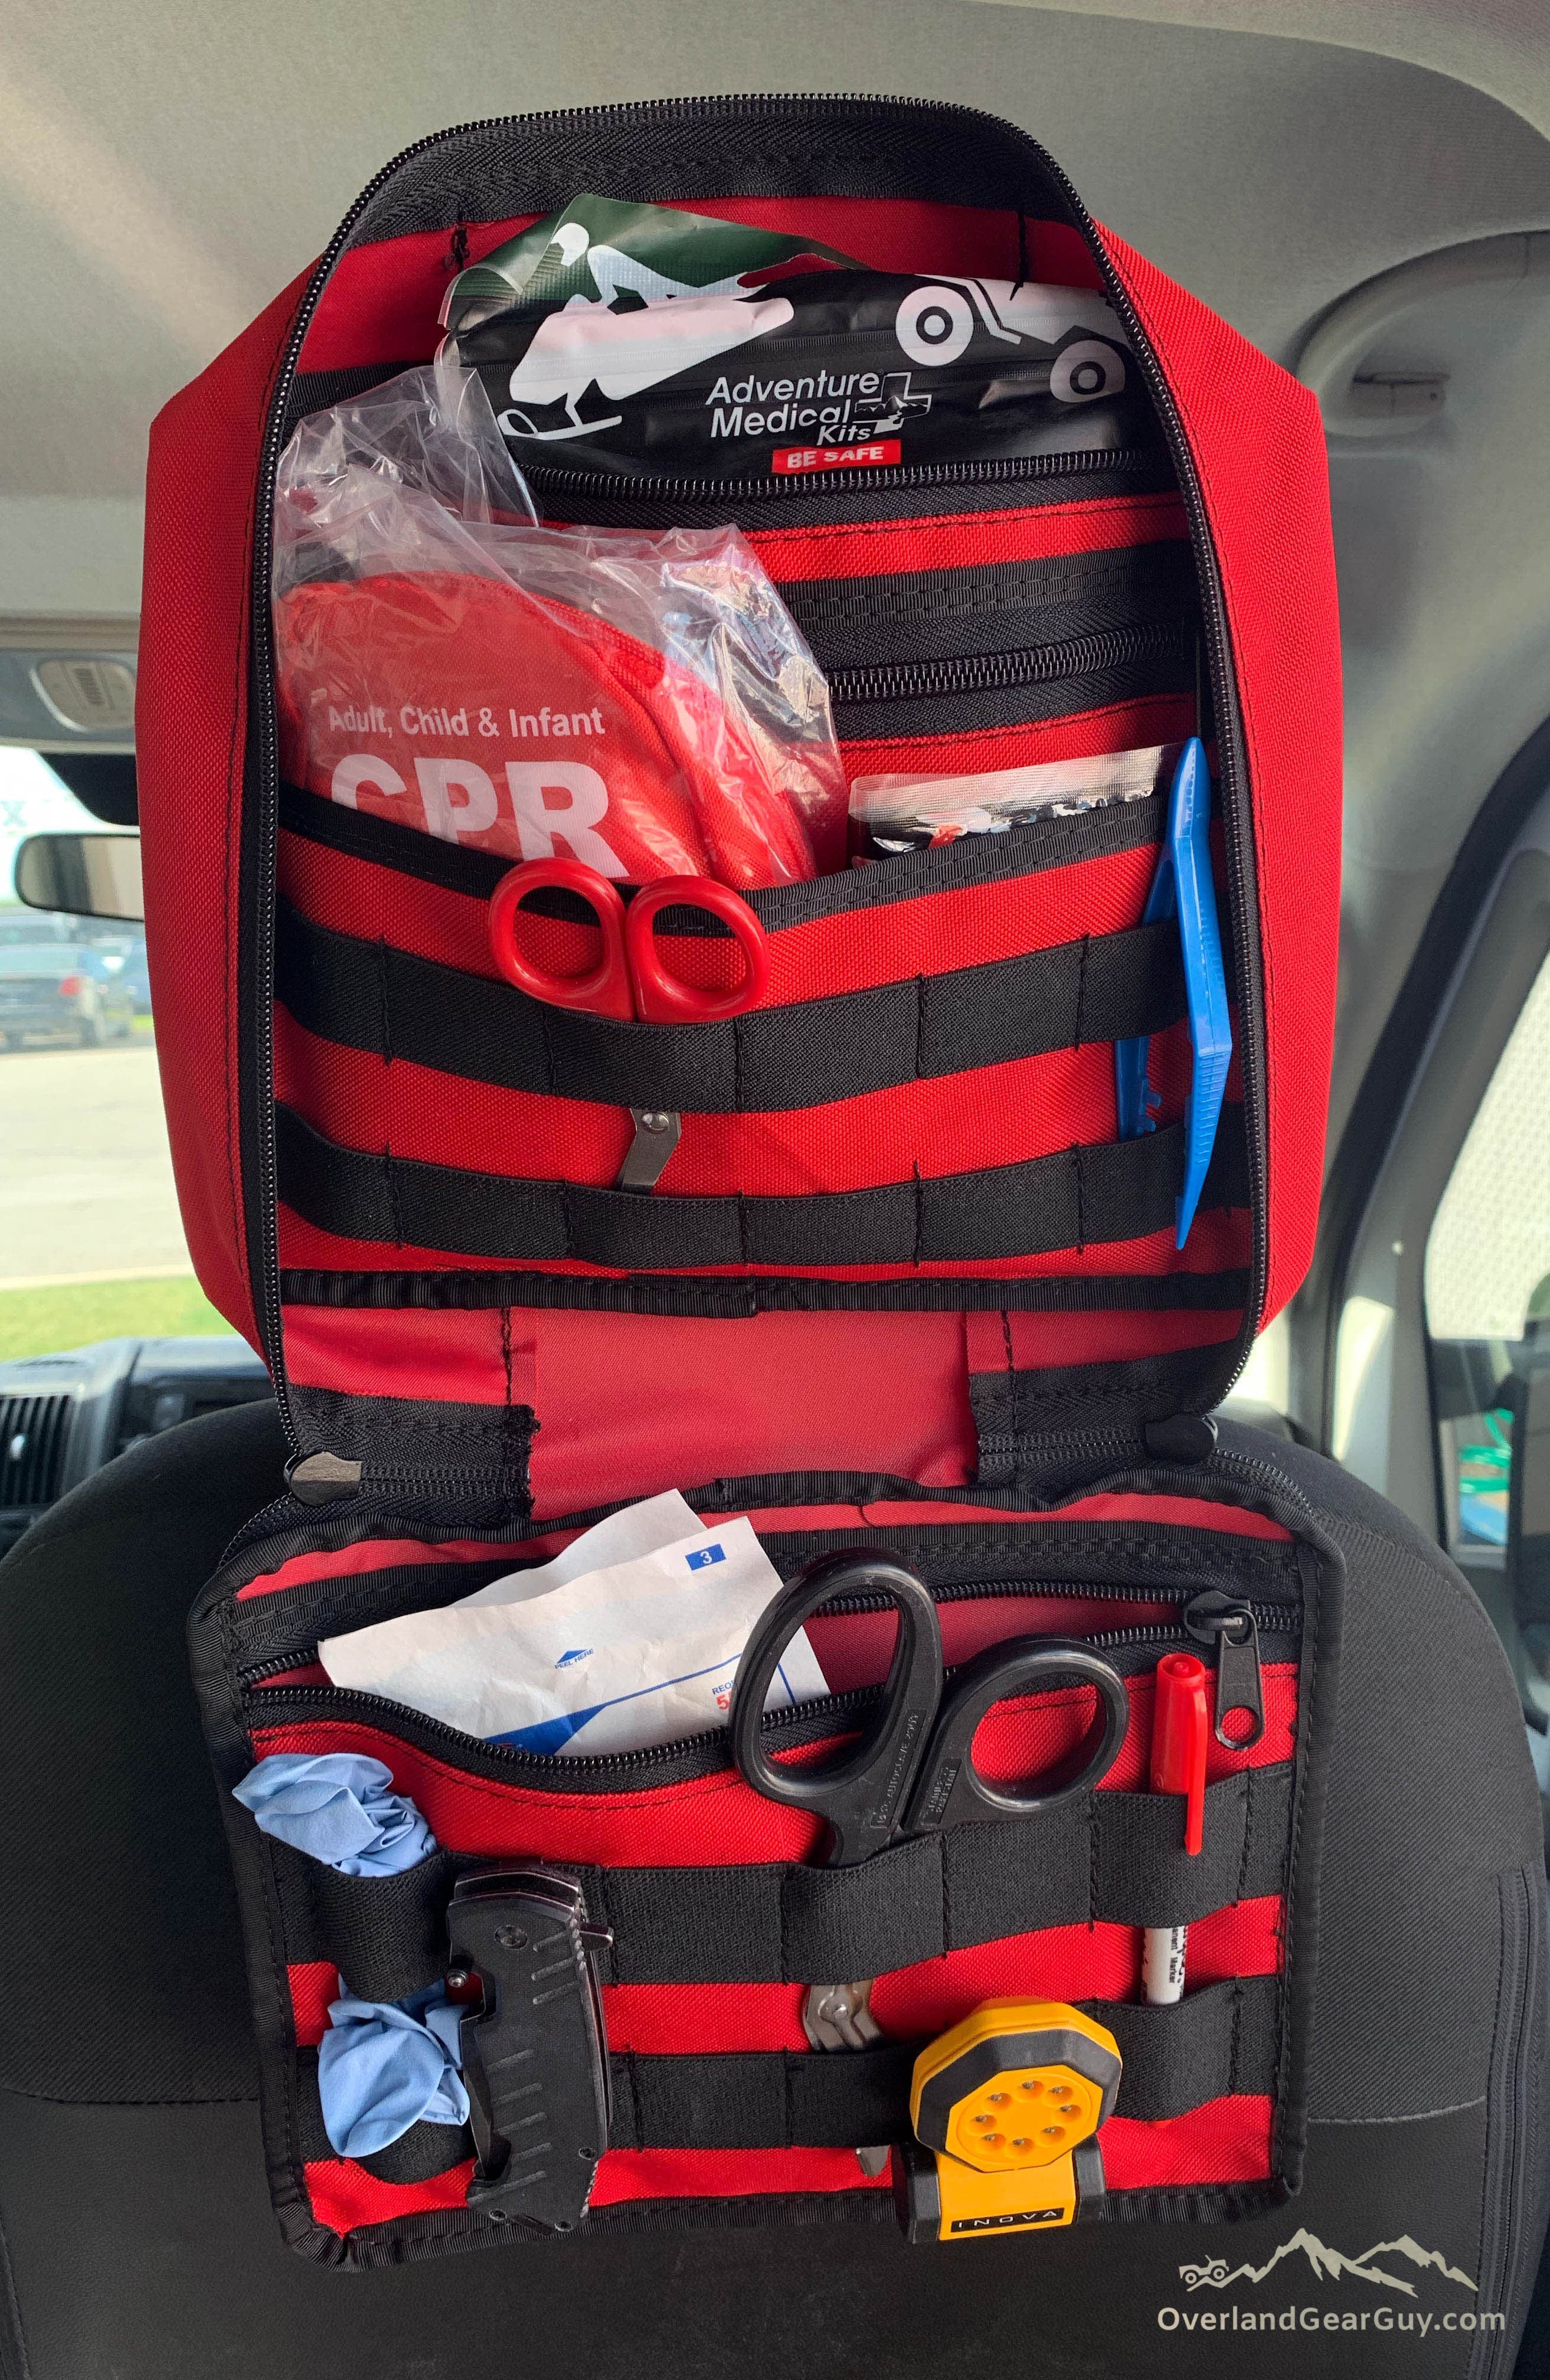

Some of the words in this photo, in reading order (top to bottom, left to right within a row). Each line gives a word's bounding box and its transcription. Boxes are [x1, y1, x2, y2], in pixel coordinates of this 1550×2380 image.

[705, 370, 880, 406] Adventure
[710, 398, 851, 438] Medical
[816, 424, 871, 446] Kits
[787, 450, 817, 469] BE
[823, 446, 884, 462] SAFE
[328, 704, 393, 739] Adult,
[400, 705, 470, 737] Child
[478, 707, 499, 738] &
[509, 706, 606, 738] Infant
[700, 1551, 712, 1564] 3
[555, 1660, 573, 1669] PEEL
[574, 1649, 594, 1662] HERE
[716, 1692, 732, 1710] 5
[1169, 1957, 1178, 1983] Marker
[958, 2211, 1057, 2228] INOVA
